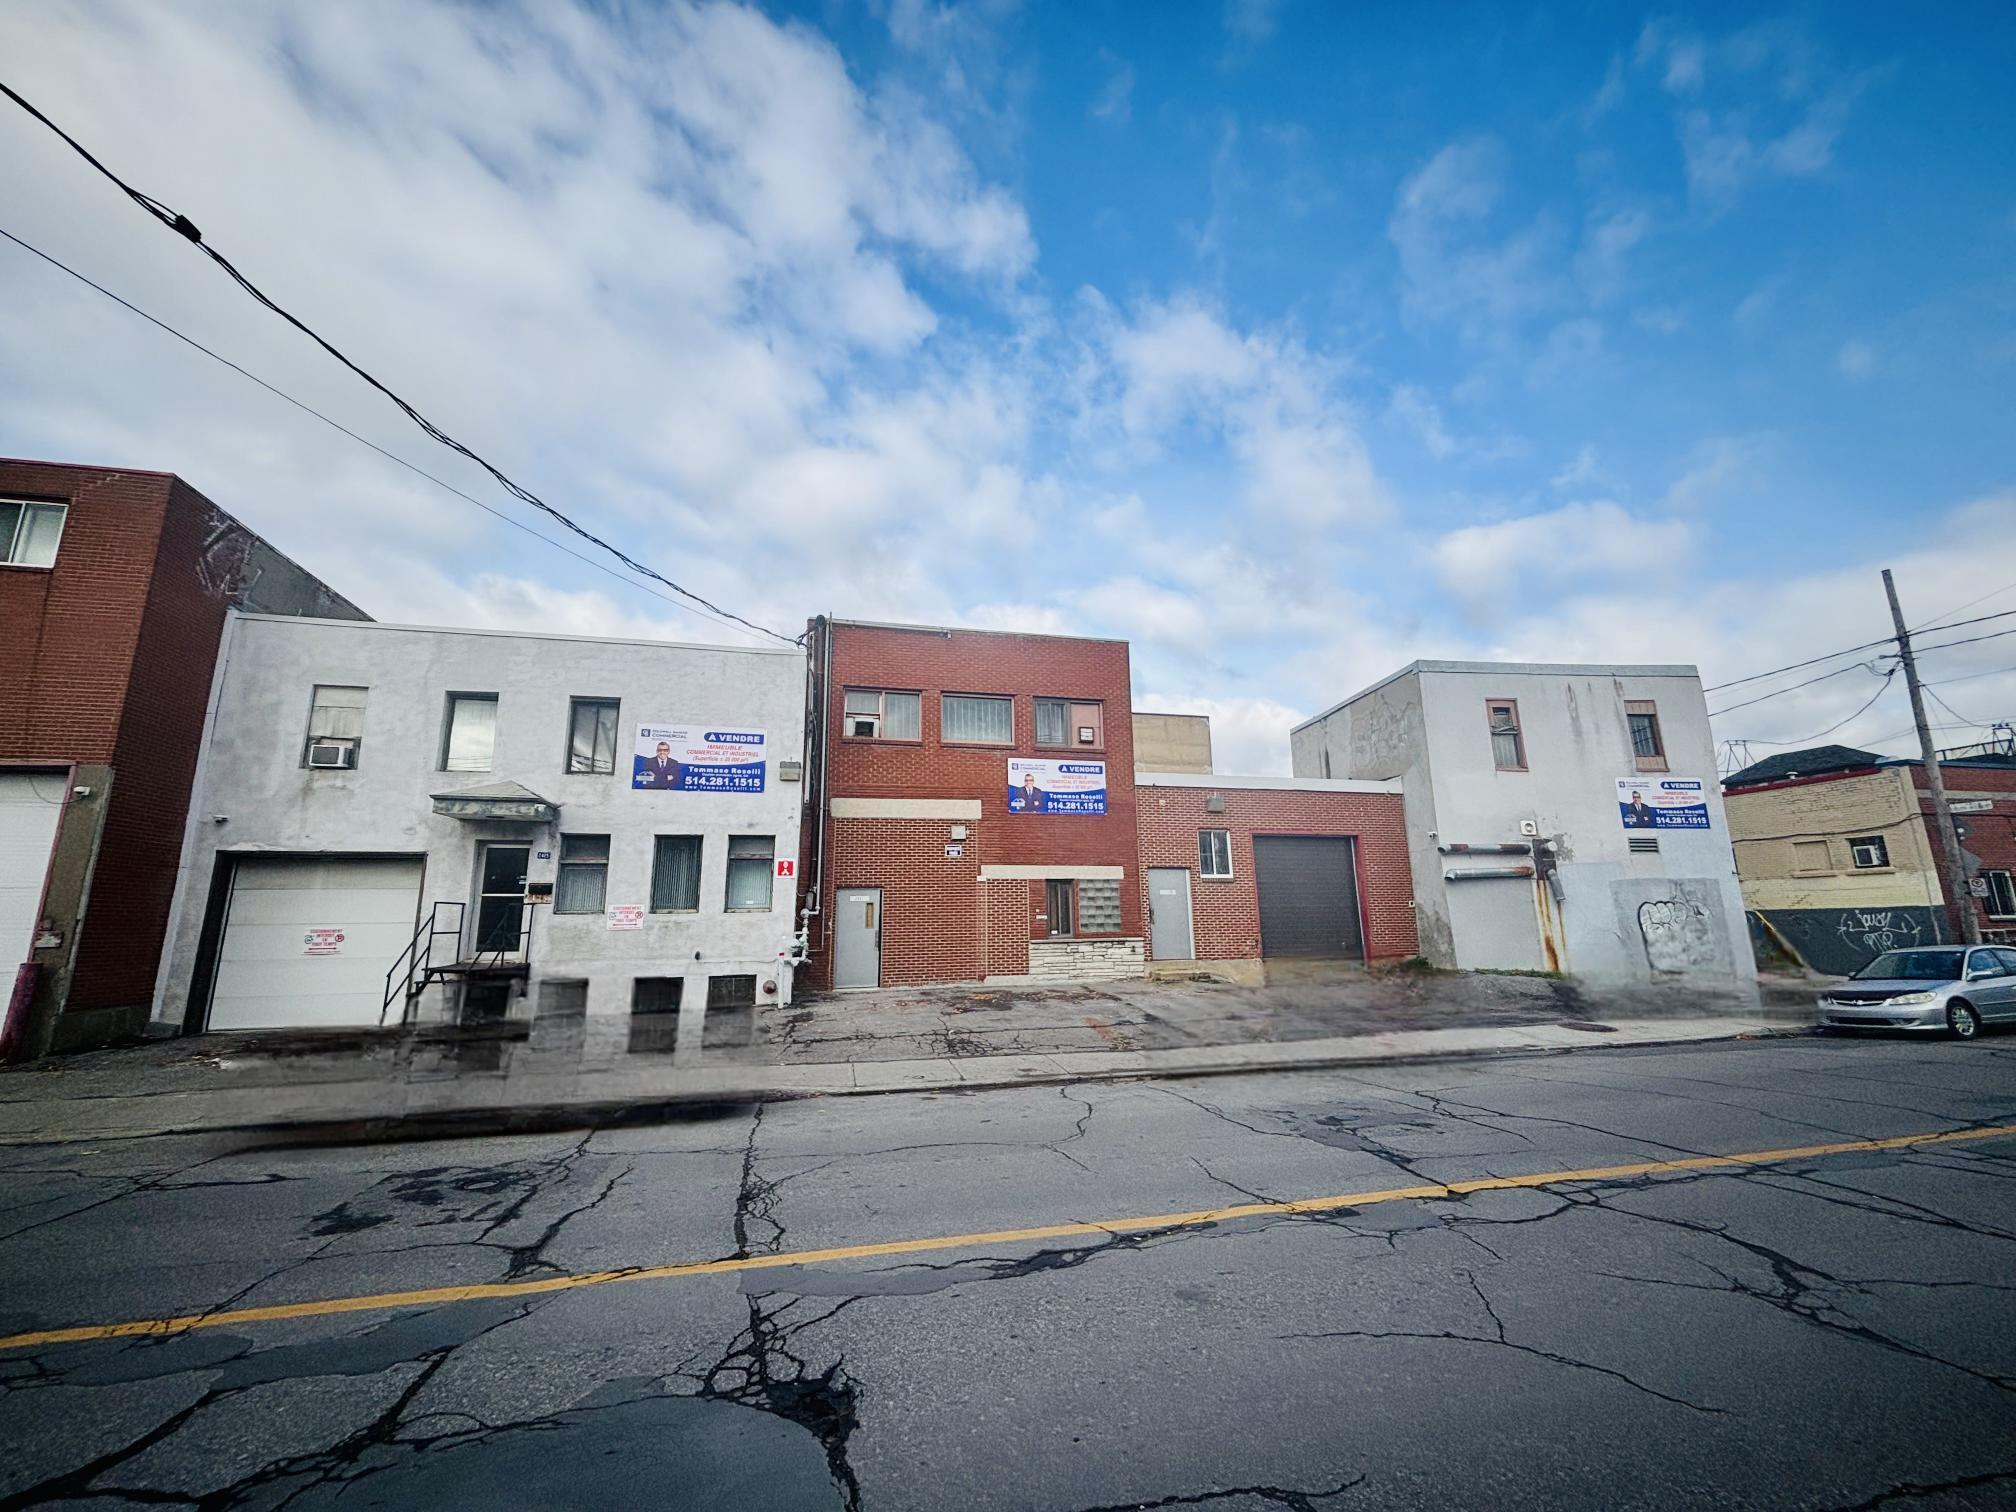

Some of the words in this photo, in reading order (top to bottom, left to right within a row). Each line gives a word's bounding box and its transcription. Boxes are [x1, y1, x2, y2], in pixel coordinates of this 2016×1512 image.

[719, 734, 760, 743] VENDRE
[689, 766, 729, 774] Tommaso
[731, 767, 761, 775] Roselli
[685, 775, 761, 787] 514.281.1515
[1047, 802, 1104, 810] 514.281.1515
[1656, 816, 1707, 824] 514.281.1515
